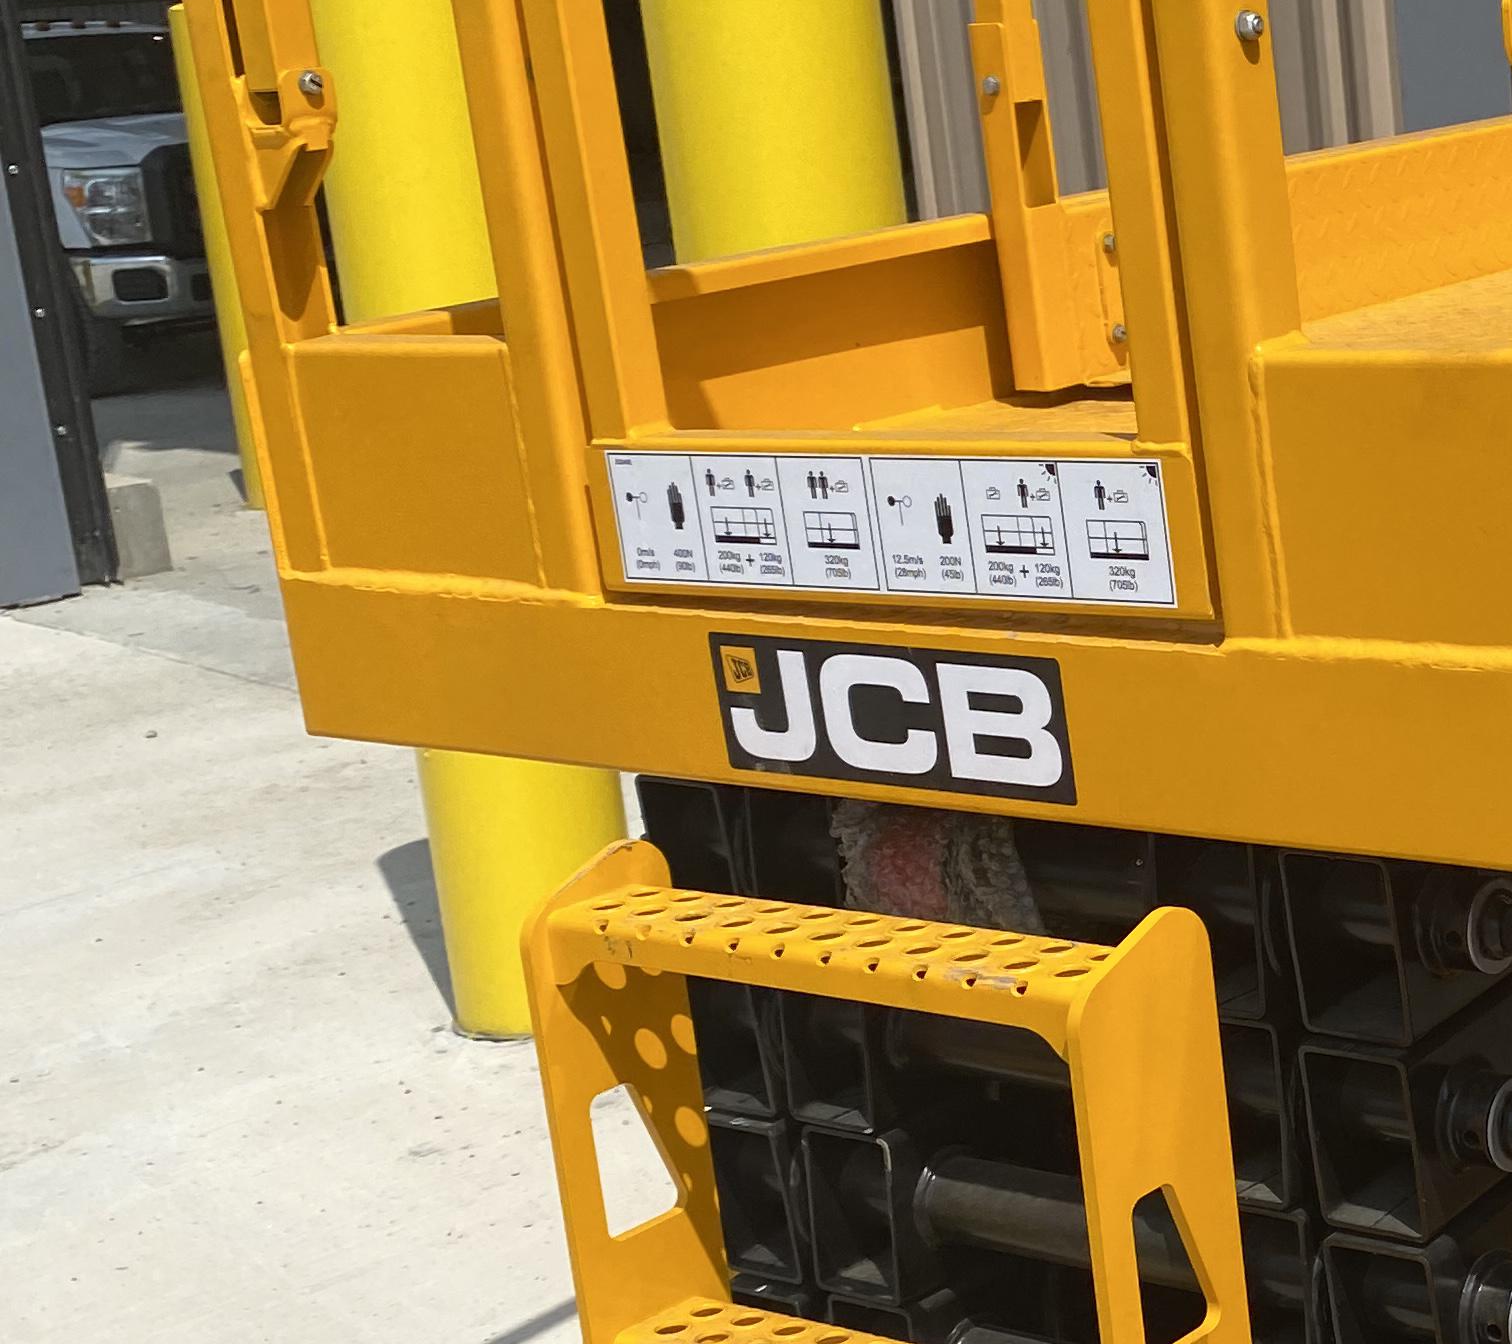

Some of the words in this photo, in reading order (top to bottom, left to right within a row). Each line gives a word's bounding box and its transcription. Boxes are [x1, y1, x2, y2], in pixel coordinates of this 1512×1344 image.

[718, 550, 742, 563] 200kg
[758, 552, 783, 564] 120kg
[824, 554, 849, 567] 320kg
[892, 554, 924, 565] 12.5m/s
[939, 555, 962, 567] 200N
[988, 560, 1014, 573] 200kg
[1034, 563, 1061, 577] 120kg
[1108, 565, 1136, 579] 320kg
[1109, 579, 1139, 593] (705lb)
[731, 658, 753, 680] JCB
[731, 649, 1062, 787] JCB
